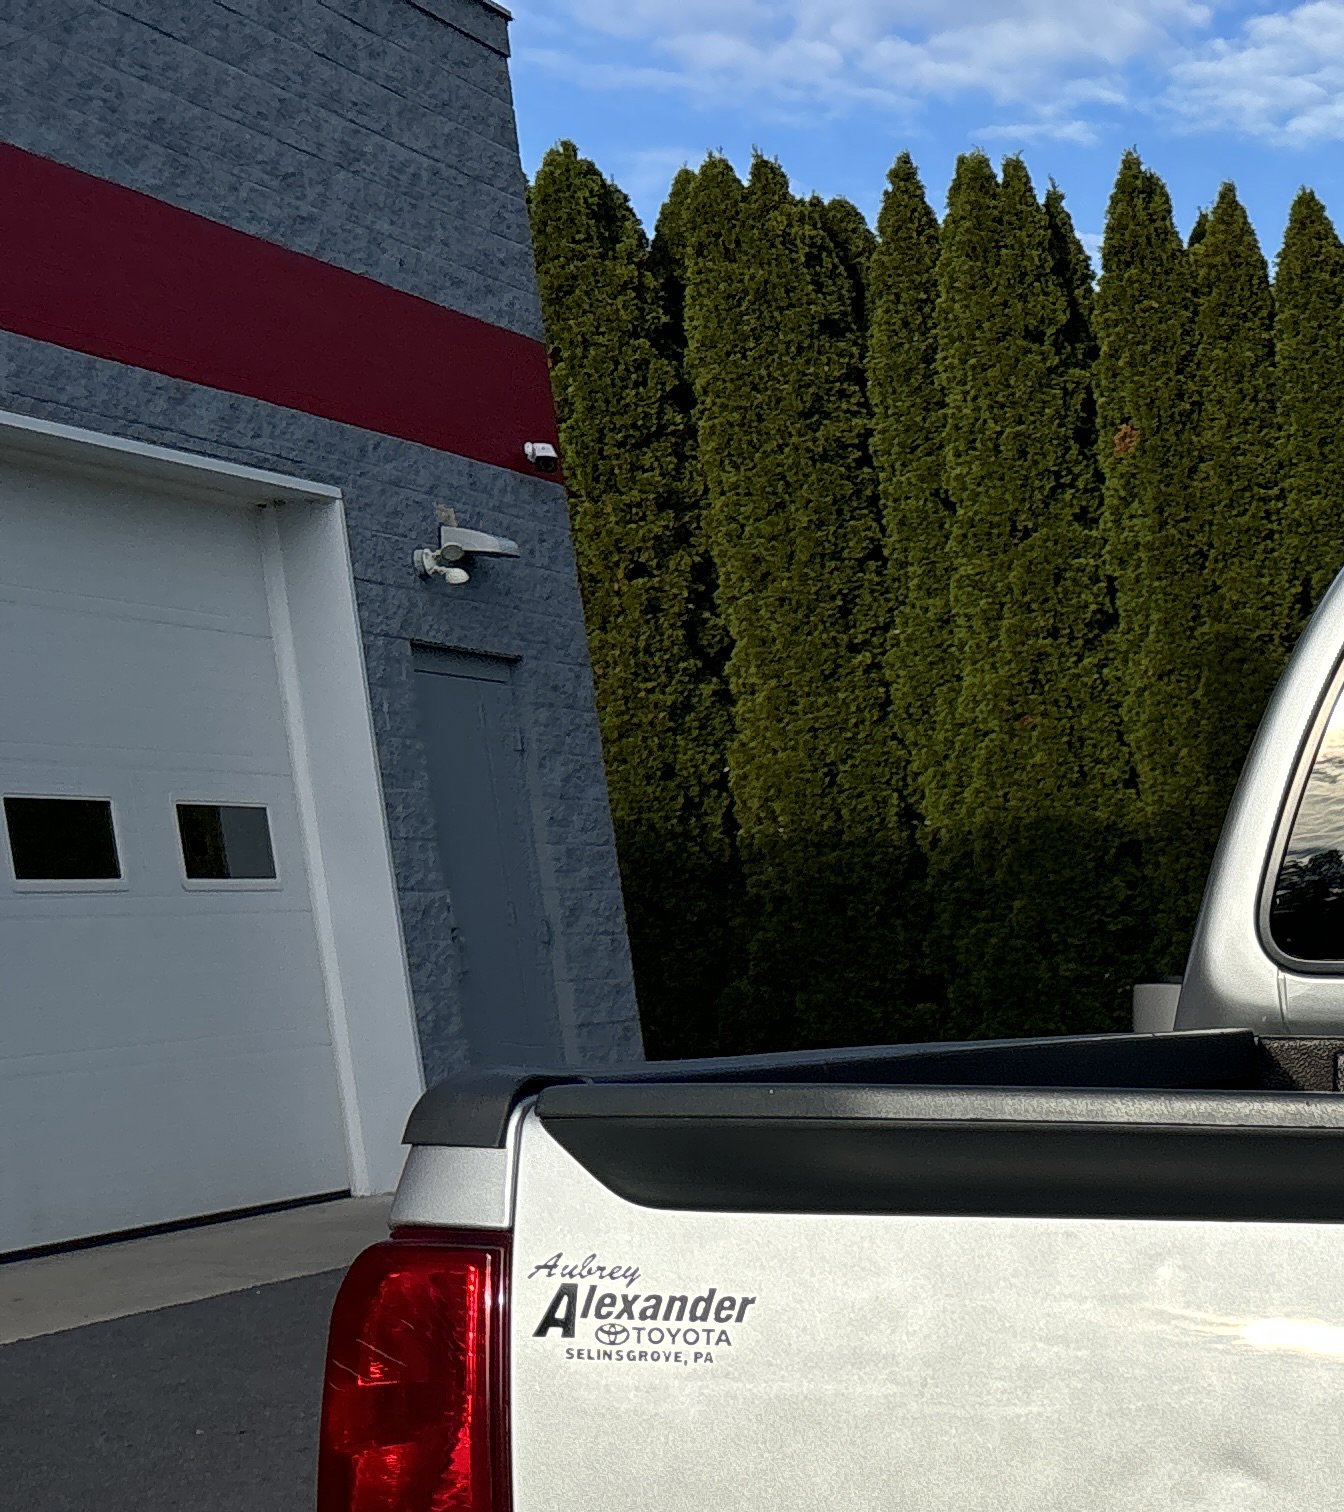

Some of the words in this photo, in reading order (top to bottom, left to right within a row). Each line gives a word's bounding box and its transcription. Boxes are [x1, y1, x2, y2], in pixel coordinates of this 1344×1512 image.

[527, 1252, 642, 1288] Aubrey
[531, 1282, 757, 1339] Alexander
[631, 1326, 733, 1347] TOYOTA
[565, 1348, 689, 1366] SELINSGROVE,
[693, 1351, 715, 1364] PA
